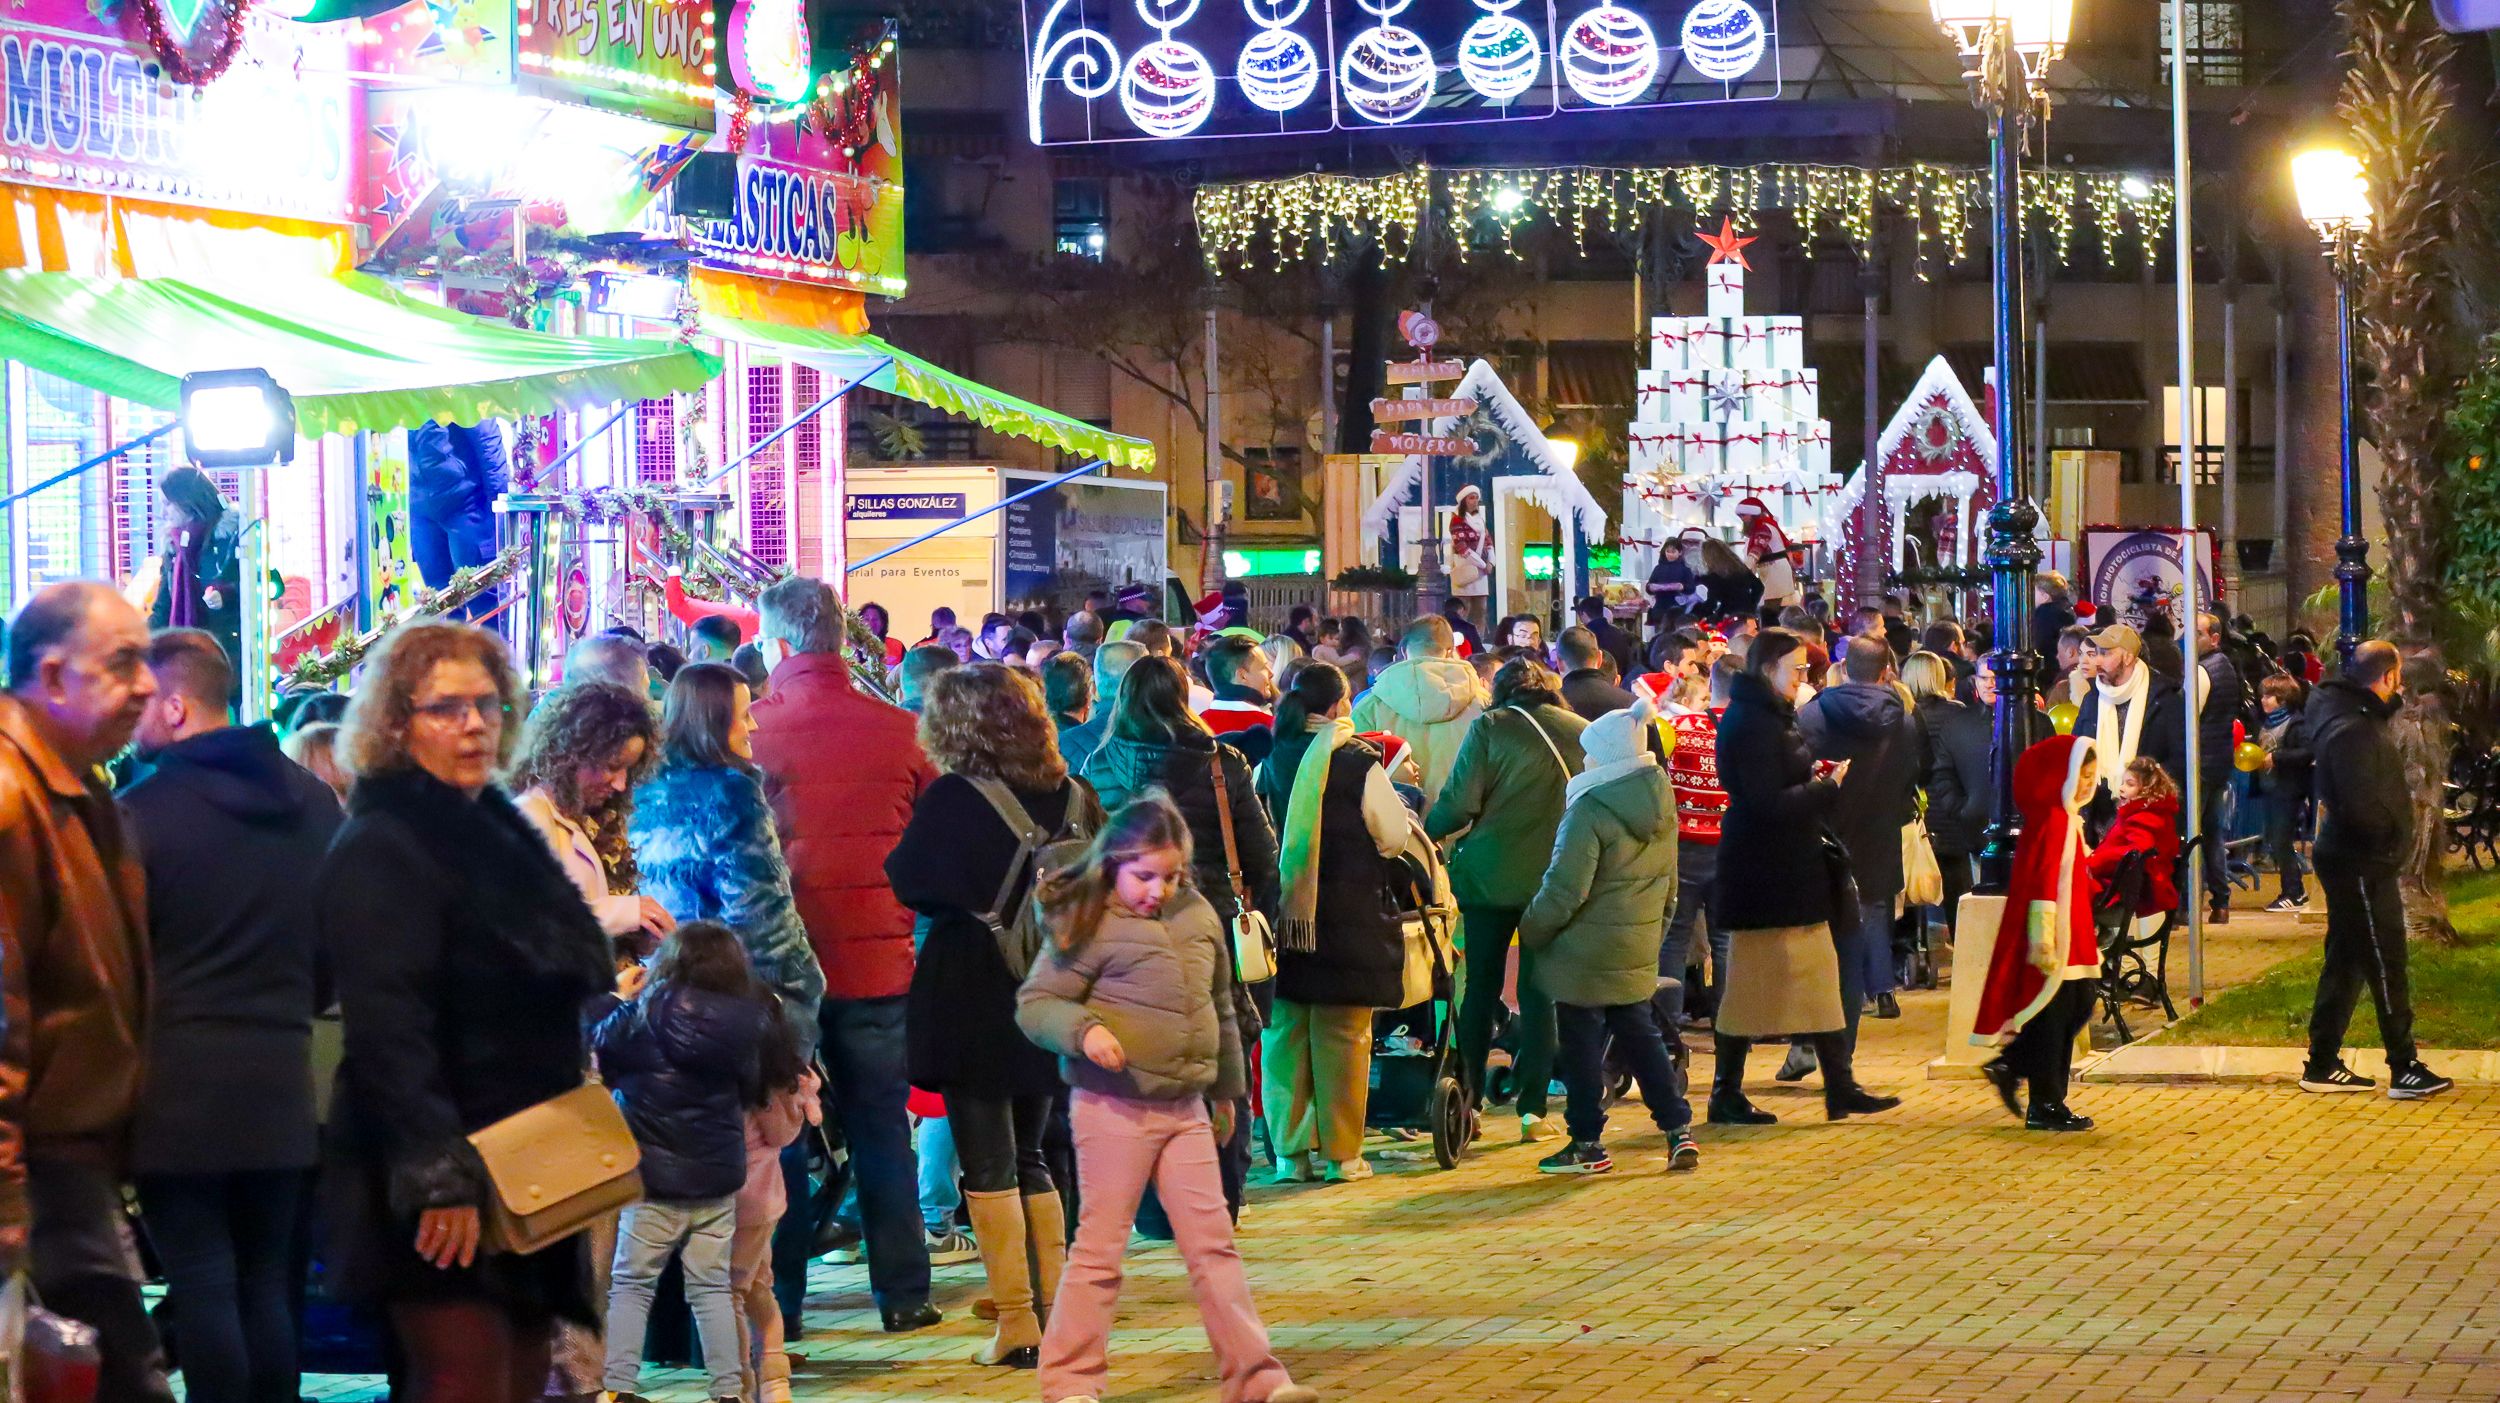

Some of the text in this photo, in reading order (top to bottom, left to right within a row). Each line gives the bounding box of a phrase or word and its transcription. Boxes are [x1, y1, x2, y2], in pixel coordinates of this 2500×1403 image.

[606, 0, 645, 59] EN
[652, 5, 706, 69] UNO
[703, 165, 836, 266] ASTICAS
[857, 496, 957, 510] SILLAS GONZÁLEZ
[852, 511, 887, 519] alquileres
[2104, 543, 2162, 582] MOTOCICLISTA
[2164, 546, 2178, 560] DE
[881, 569, 906, 581] para
[914, 567, 960, 577] Eventos
[1699, 755, 1716, 765] ME
